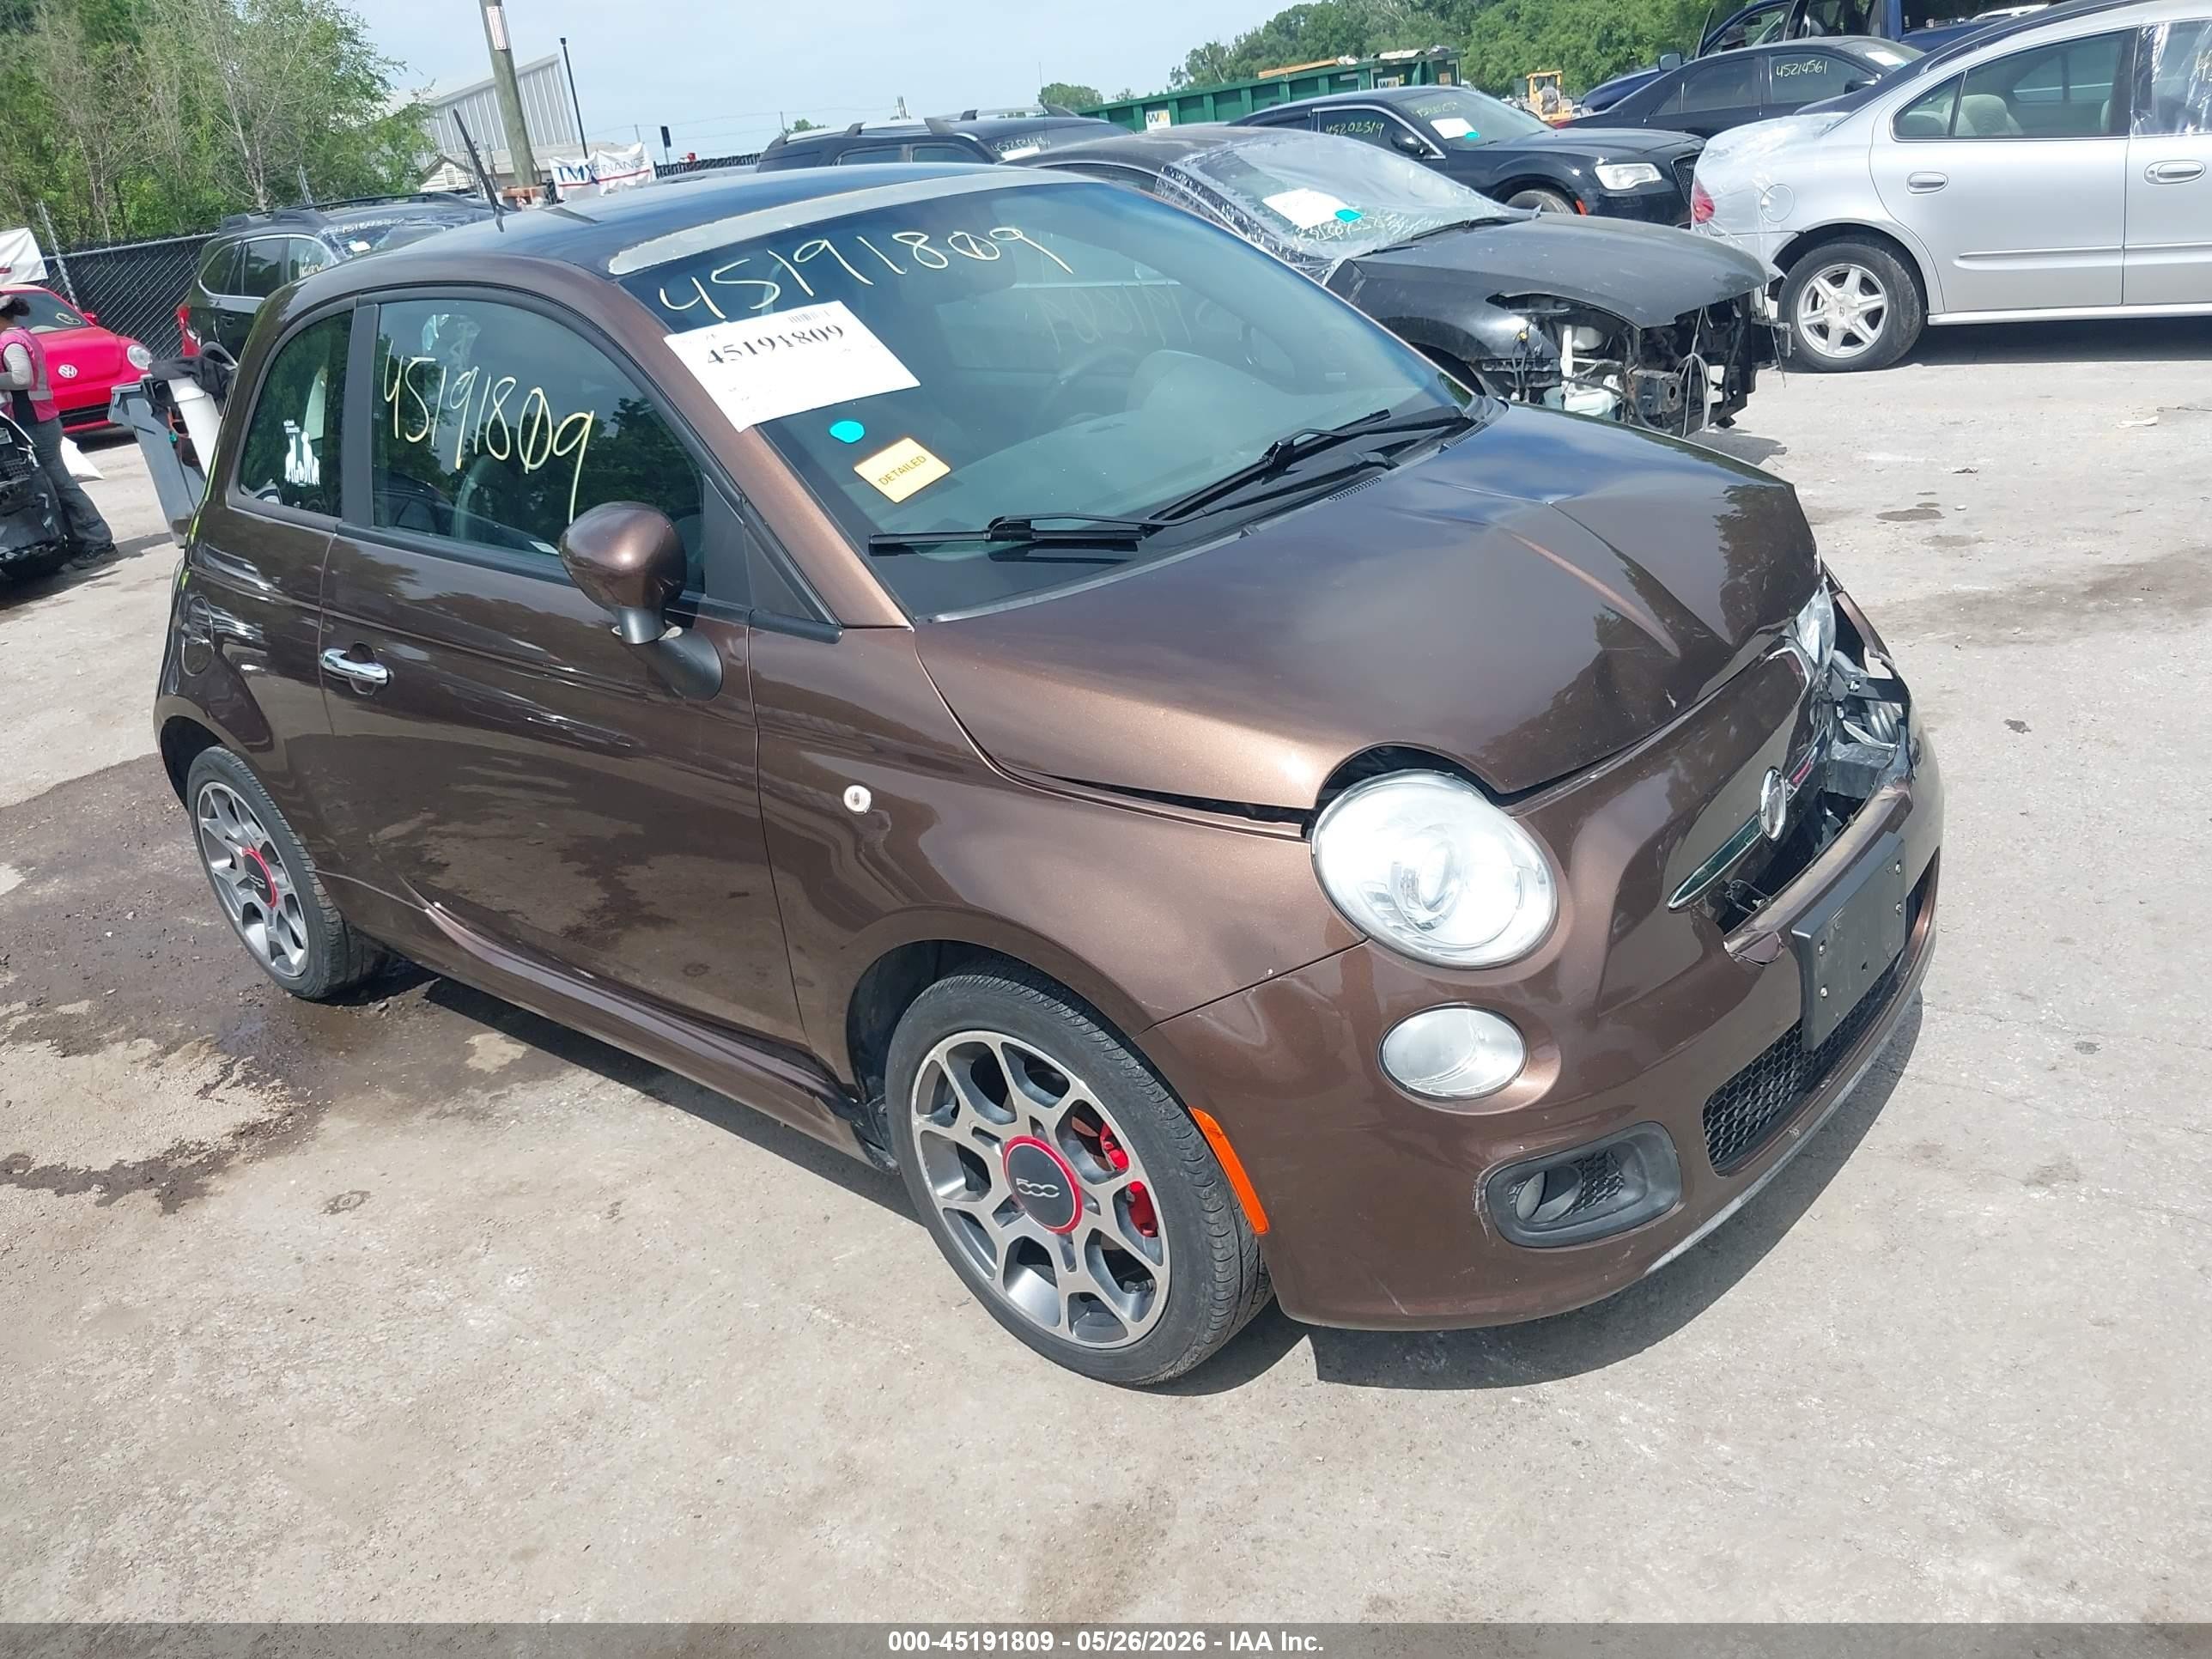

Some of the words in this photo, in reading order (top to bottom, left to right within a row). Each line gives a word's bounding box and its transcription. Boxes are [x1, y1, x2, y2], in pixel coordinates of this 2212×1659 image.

[1776, 59, 1828, 78] 45214561
[556, 164, 599, 184] TMX
[659, 227, 1074, 319] 45191809
[708, 324, 843, 364] 45191809
[383, 339, 596, 525] 45191809
[878, 455, 927, 486] DETAILED
[1016, 1178, 1060, 1198] 500
